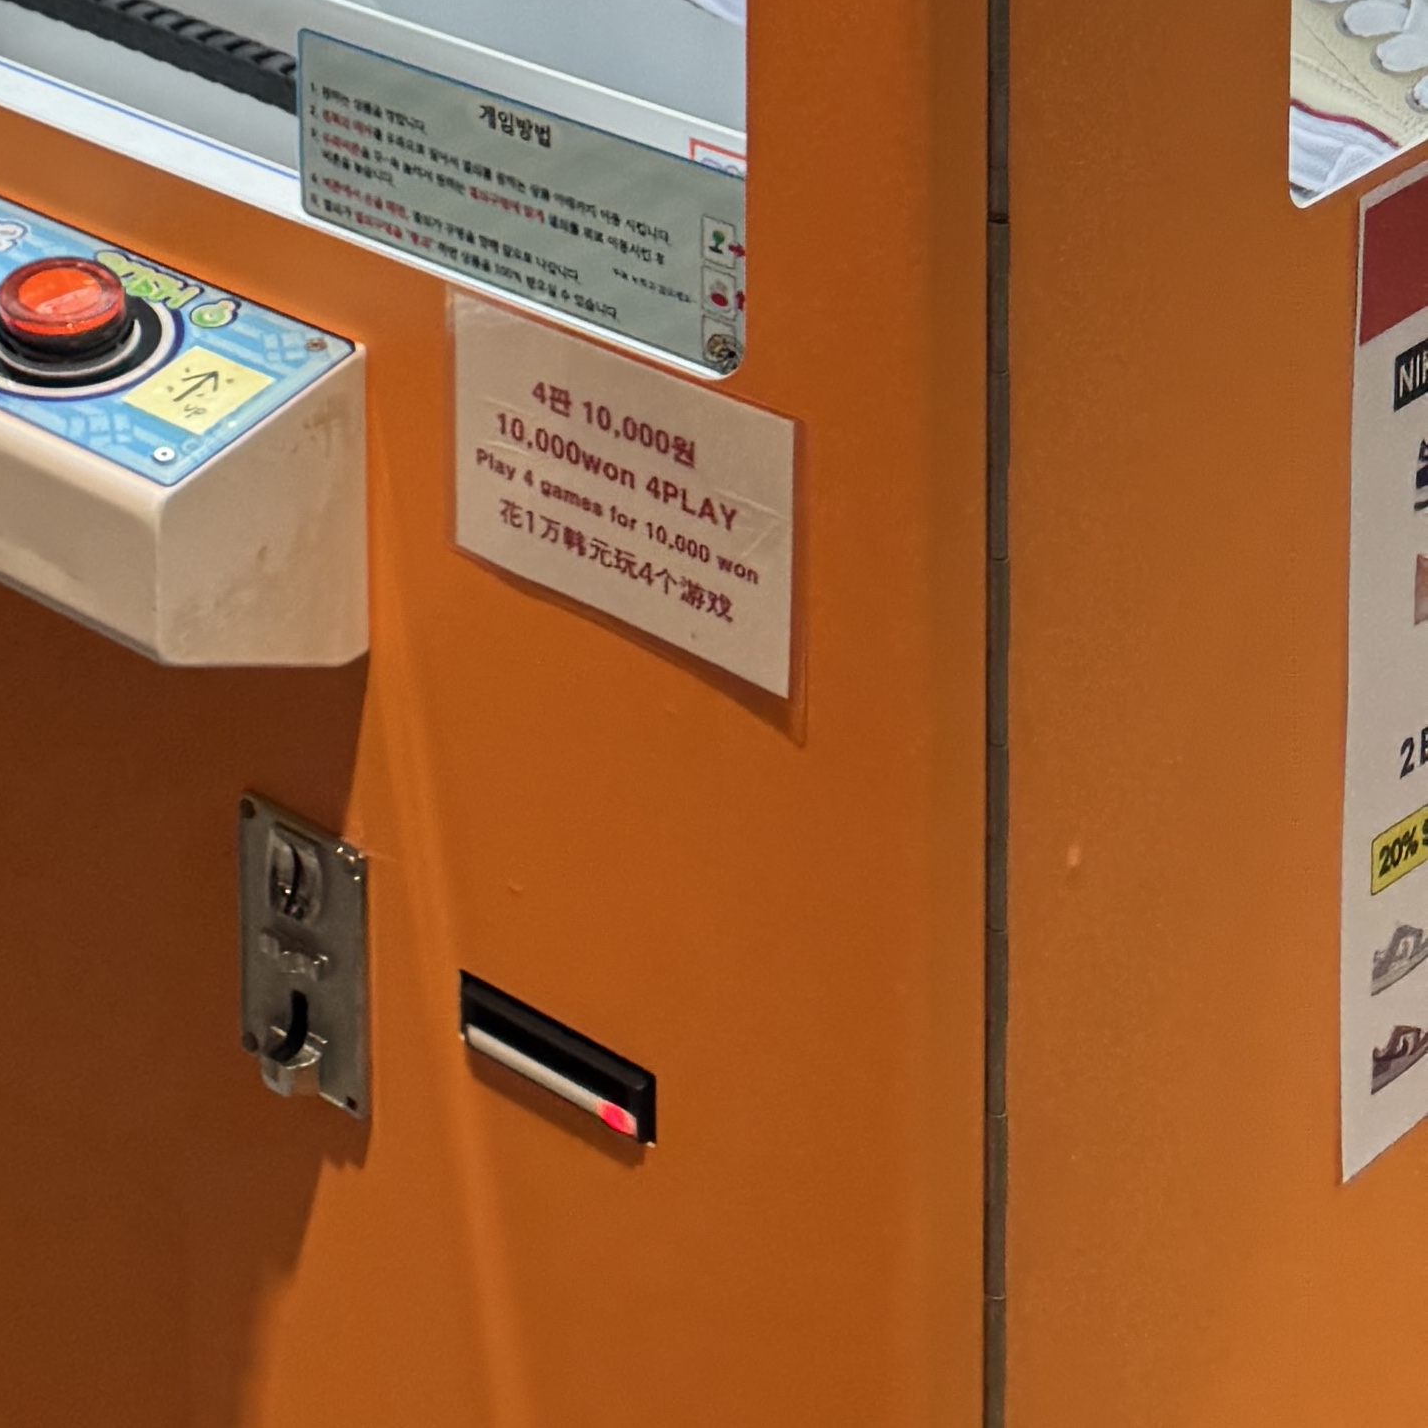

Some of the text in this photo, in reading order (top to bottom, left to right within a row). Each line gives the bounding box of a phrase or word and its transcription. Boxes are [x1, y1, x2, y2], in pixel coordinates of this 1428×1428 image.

[479, 105, 551, 148] 게임방법
[476, 447, 516, 481] Play
[523, 468, 534, 487] 4
[540, 479, 603, 517] games
[610, 505, 637, 531] for
[716, 555, 759, 585] won
[646, 475, 738, 532] 4PLAY
[1378, 824, 1419, 878] 20%
